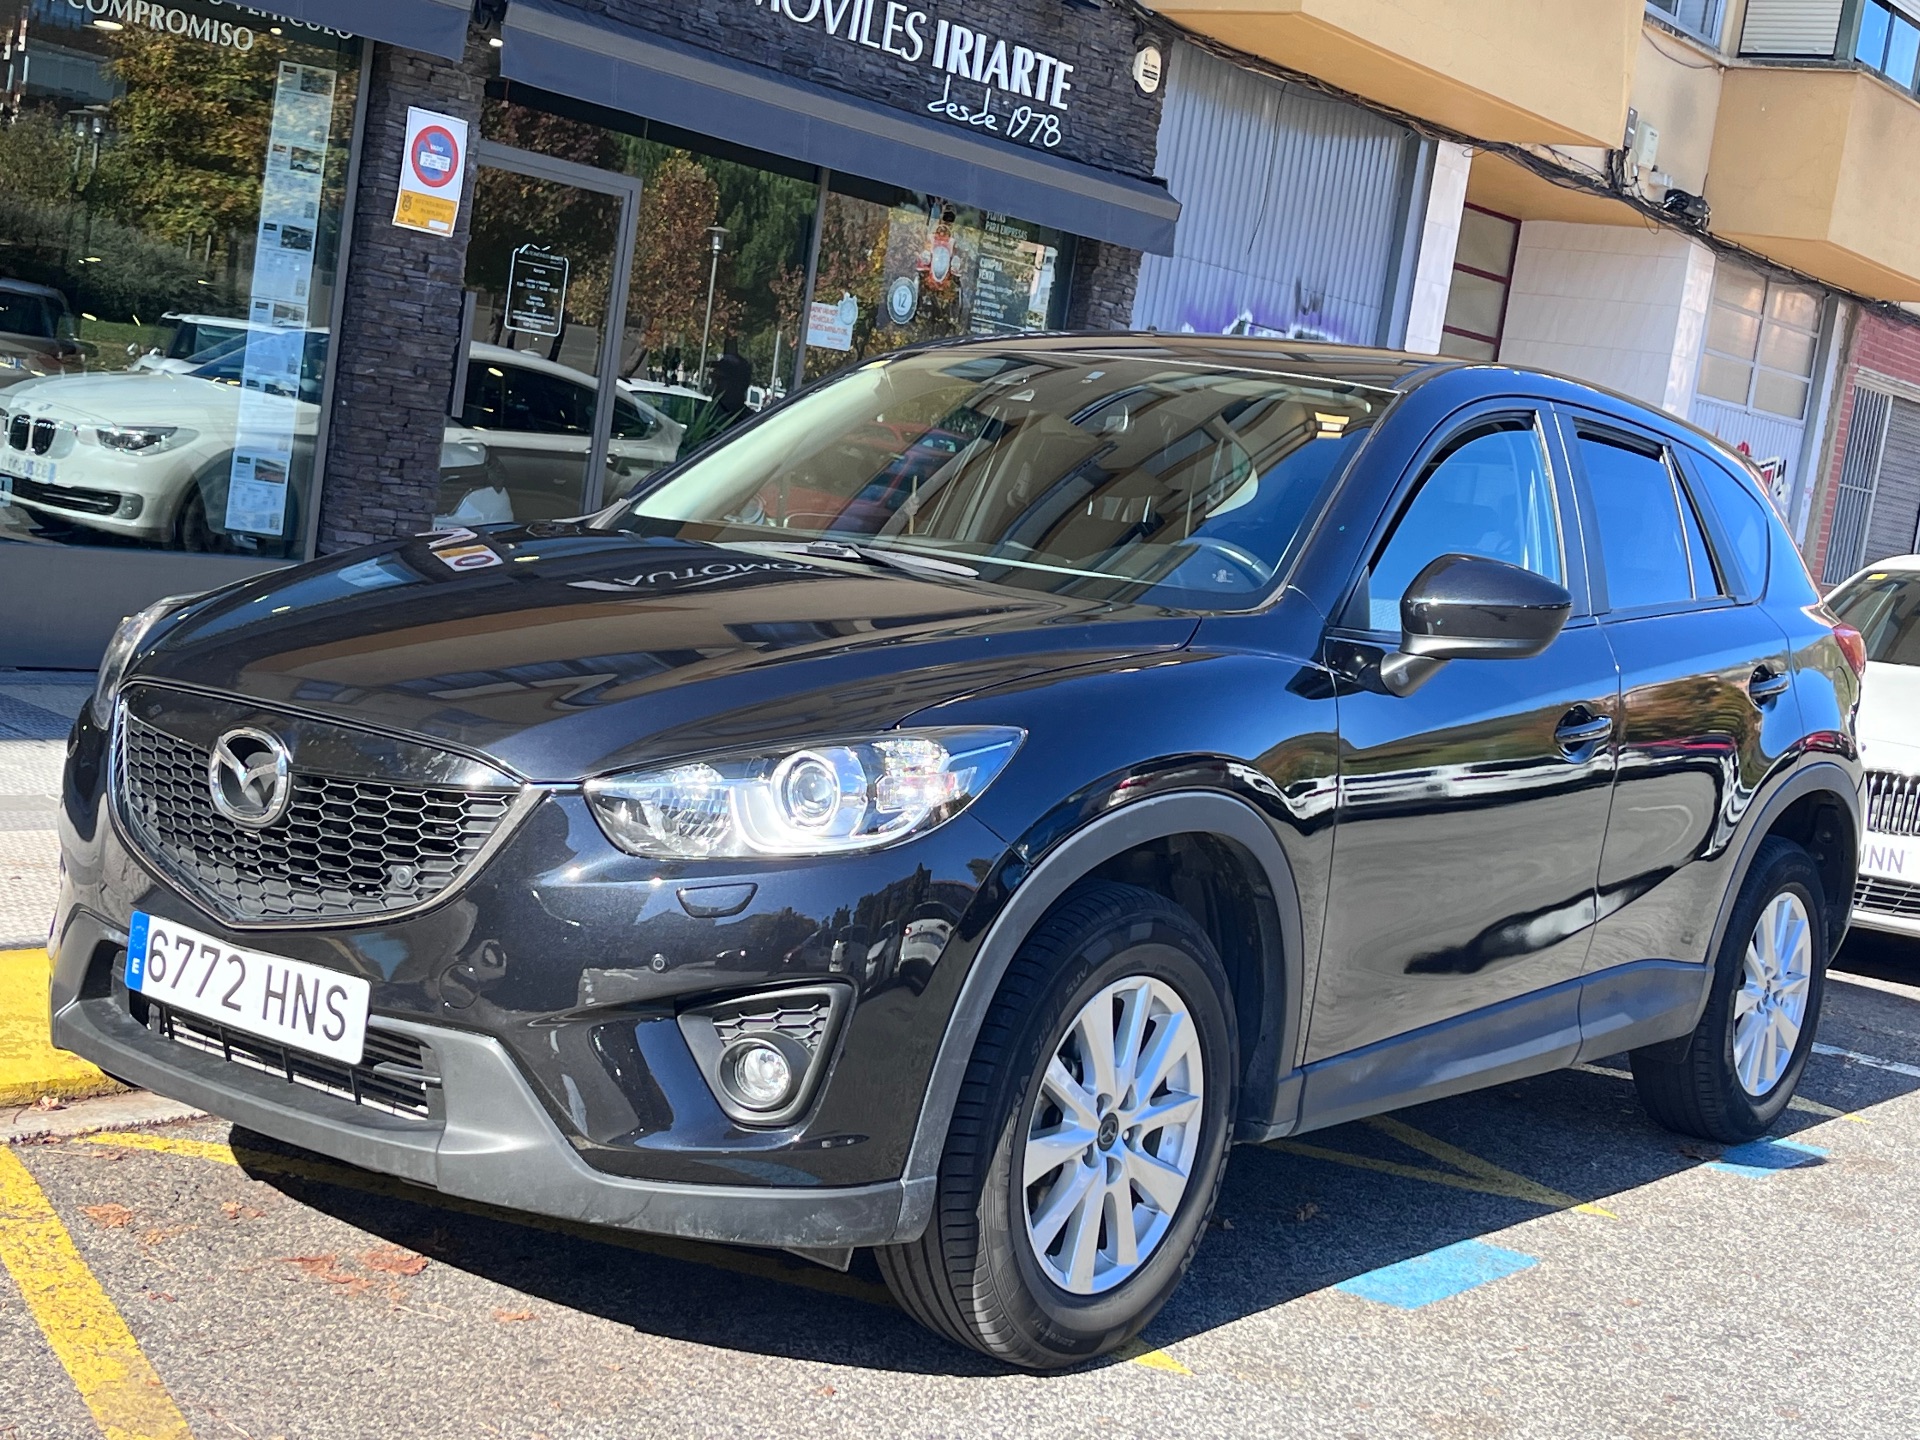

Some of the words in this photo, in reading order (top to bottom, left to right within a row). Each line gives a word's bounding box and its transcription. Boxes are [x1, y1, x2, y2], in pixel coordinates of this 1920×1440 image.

[932, 19, 1075, 111] IRIARTE
[927, 74, 998, 131] desde
[1006, 106, 1062, 148] 1978
[1862, 844, 1905, 874] NN
[131, 957, 140, 975] E
[147, 929, 247, 1012] 6772
[262, 964, 349, 1042] HNS
